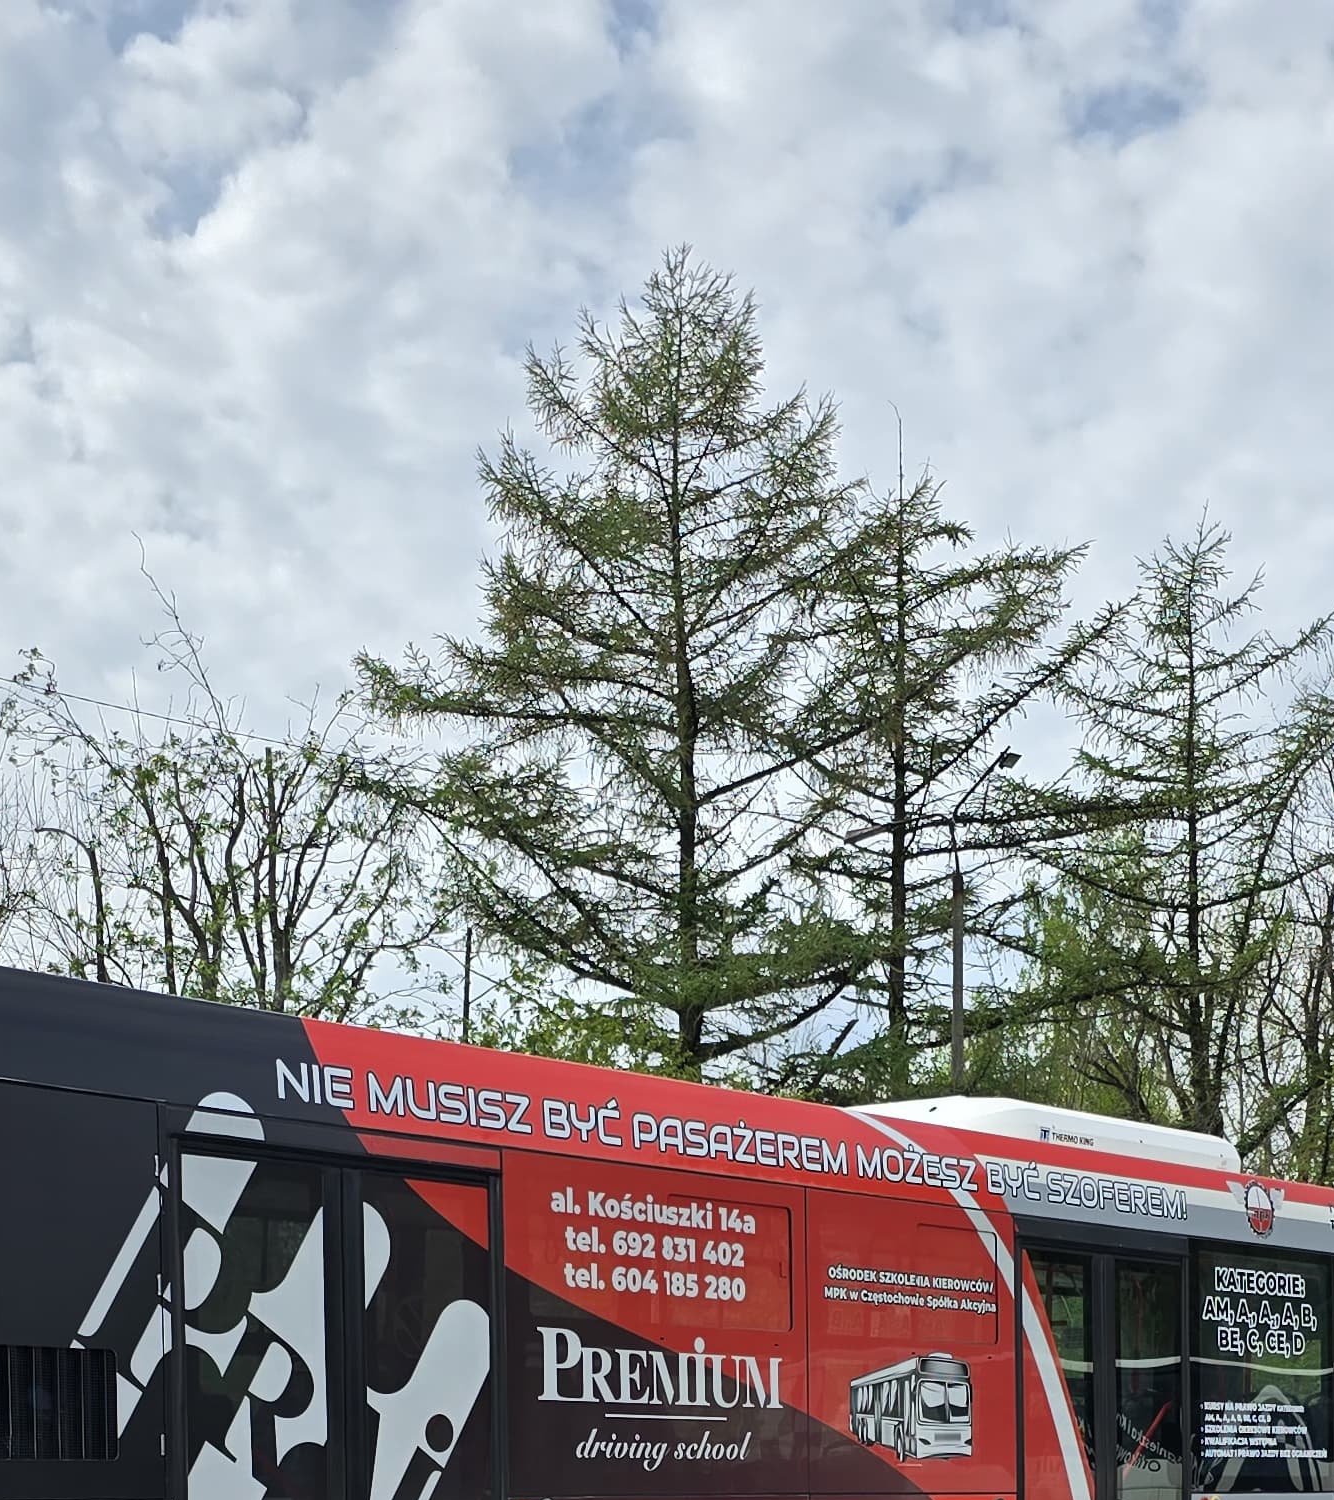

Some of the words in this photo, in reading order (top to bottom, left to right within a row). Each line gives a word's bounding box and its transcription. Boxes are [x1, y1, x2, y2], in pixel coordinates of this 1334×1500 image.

[275, 1058, 354, 1110] NIE
[367, 1071, 532, 1134] MUSISZ
[542, 1098, 623, 1146] BYĆ
[633, 1113, 848, 1175] PASAŻEREM
[857, 1144, 978, 1191] MOŻESZ
[986, 1161, 1040, 1201] BYĆ
[1047, 1171, 1188, 1220] SZOFEREM!
[550, 1187, 581, 1216] al.
[588, 1189, 713, 1232] Kościuszki
[719, 1207, 756, 1236] 14a
[565, 1226, 606, 1256] tel.
[612, 1230, 655, 1261] 692
[661, 1235, 696, 1264] 831
[702, 1238, 745, 1269] 402
[564, 1263, 606, 1293] tel.
[611, 1266, 659, 1296] 604
[664, 1271, 699, 1300] 185
[704, 1274, 746, 1303] 280
[828, 1265, 876, 1283] OŚRODEK
[879, 1271, 930, 1288] SZKOLENIA
[932, 1277, 994, 1294] KIEROWCÓW
[1214, 1266, 1306, 1298] KATEGORIE:
[824, 1287, 847, 1300] MPK
[849, 1291, 859, 1301] w
[861, 1289, 925, 1306] Częstochowie
[926, 1295, 958, 1311] Spółka
[960, 1300, 997, 1317] Akcyjna
[1202, 1295, 1235, 1326] AM,
[1282, 1302, 1299, 1331] A,
[1301, 1303, 1318, 1332] B,
[1217, 1326, 1245, 1357] BE,
[1247, 1328, 1263, 1357] C,
[1265, 1330, 1291, 1359] CE,
[1292, 1331, 1306, 1355] D
[576, 1429, 669, 1471] driving
[673, 1430, 752, 1461] school
